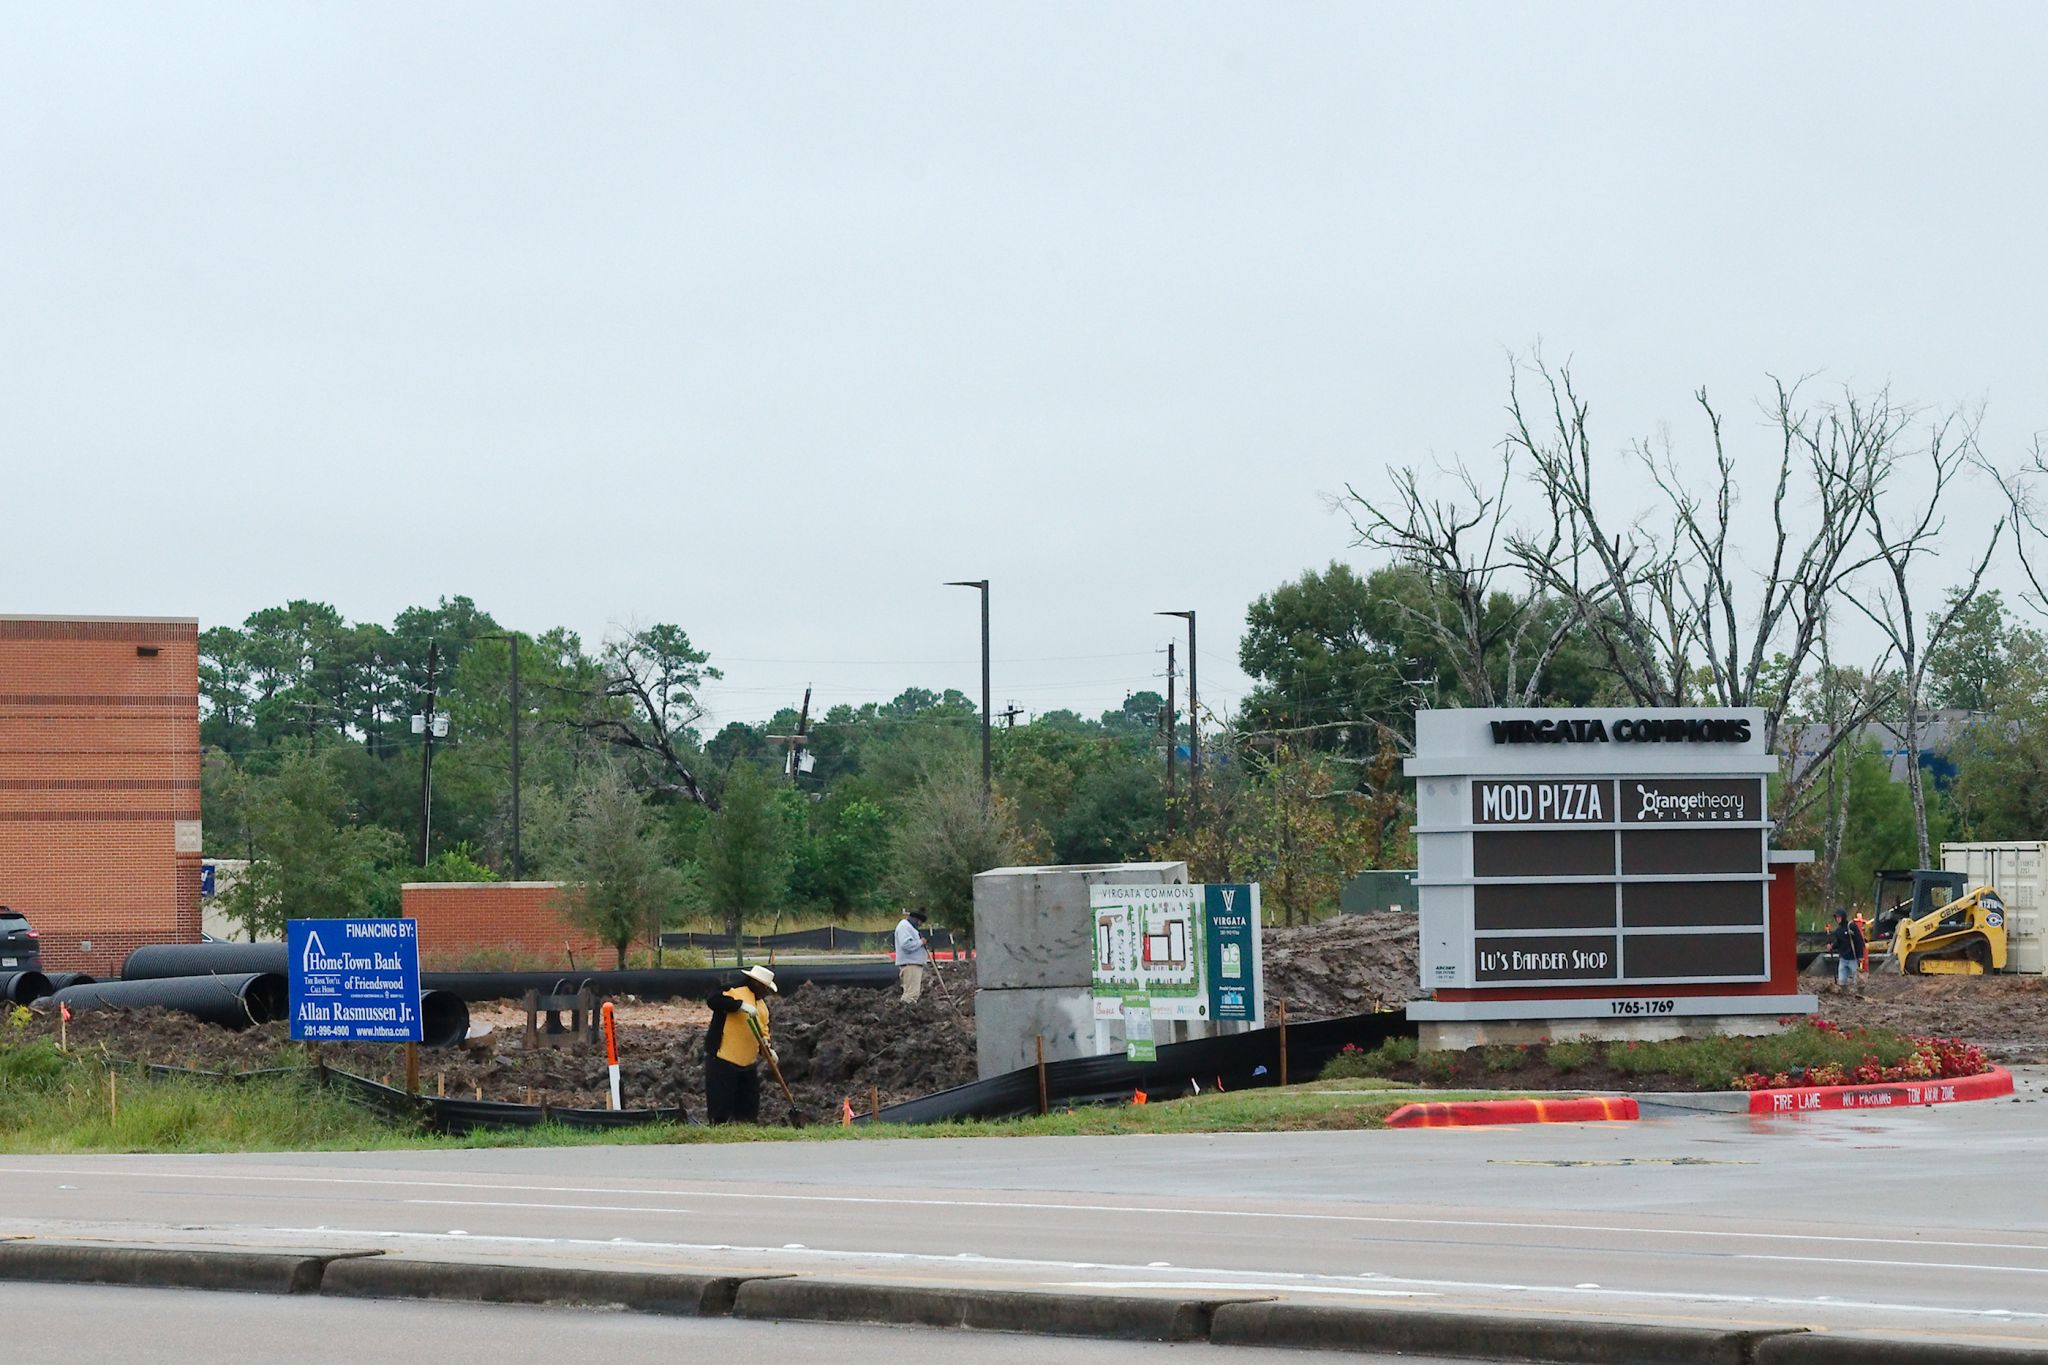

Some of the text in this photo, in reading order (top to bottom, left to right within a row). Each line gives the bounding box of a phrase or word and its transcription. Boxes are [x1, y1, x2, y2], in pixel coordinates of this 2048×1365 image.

[1490, 718, 1751, 744] VIRGATA COMMONS
[1482, 784, 1603, 821] MOD PIZZA
[1658, 811, 1744, 819] FITNESS
[1102, 888, 1194, 899] VIRGATA COMMONS
[1940, 905, 1962, 919] GEHL
[1212, 916, 1247, 926] VIRGATA
[346, 923, 414, 938] FINANCING BY:
[309, 951, 403, 971] HomeTown Bank
[344, 975, 404, 990] of Friendswood
[298, 1002, 415, 1024] Allan Rasmussen Jr.
[1611, 1000, 1675, 1015] 1765-1769
[356, 1025, 410, 1037] www.htbna.com
[1773, 1092, 1821, 1111] FIRE LANE
[1842, 1091, 1892, 1106] NO PARKING
[1907, 1088, 1920, 1104] TOW
[1941, 1085, 1956, 1101] ZONE
